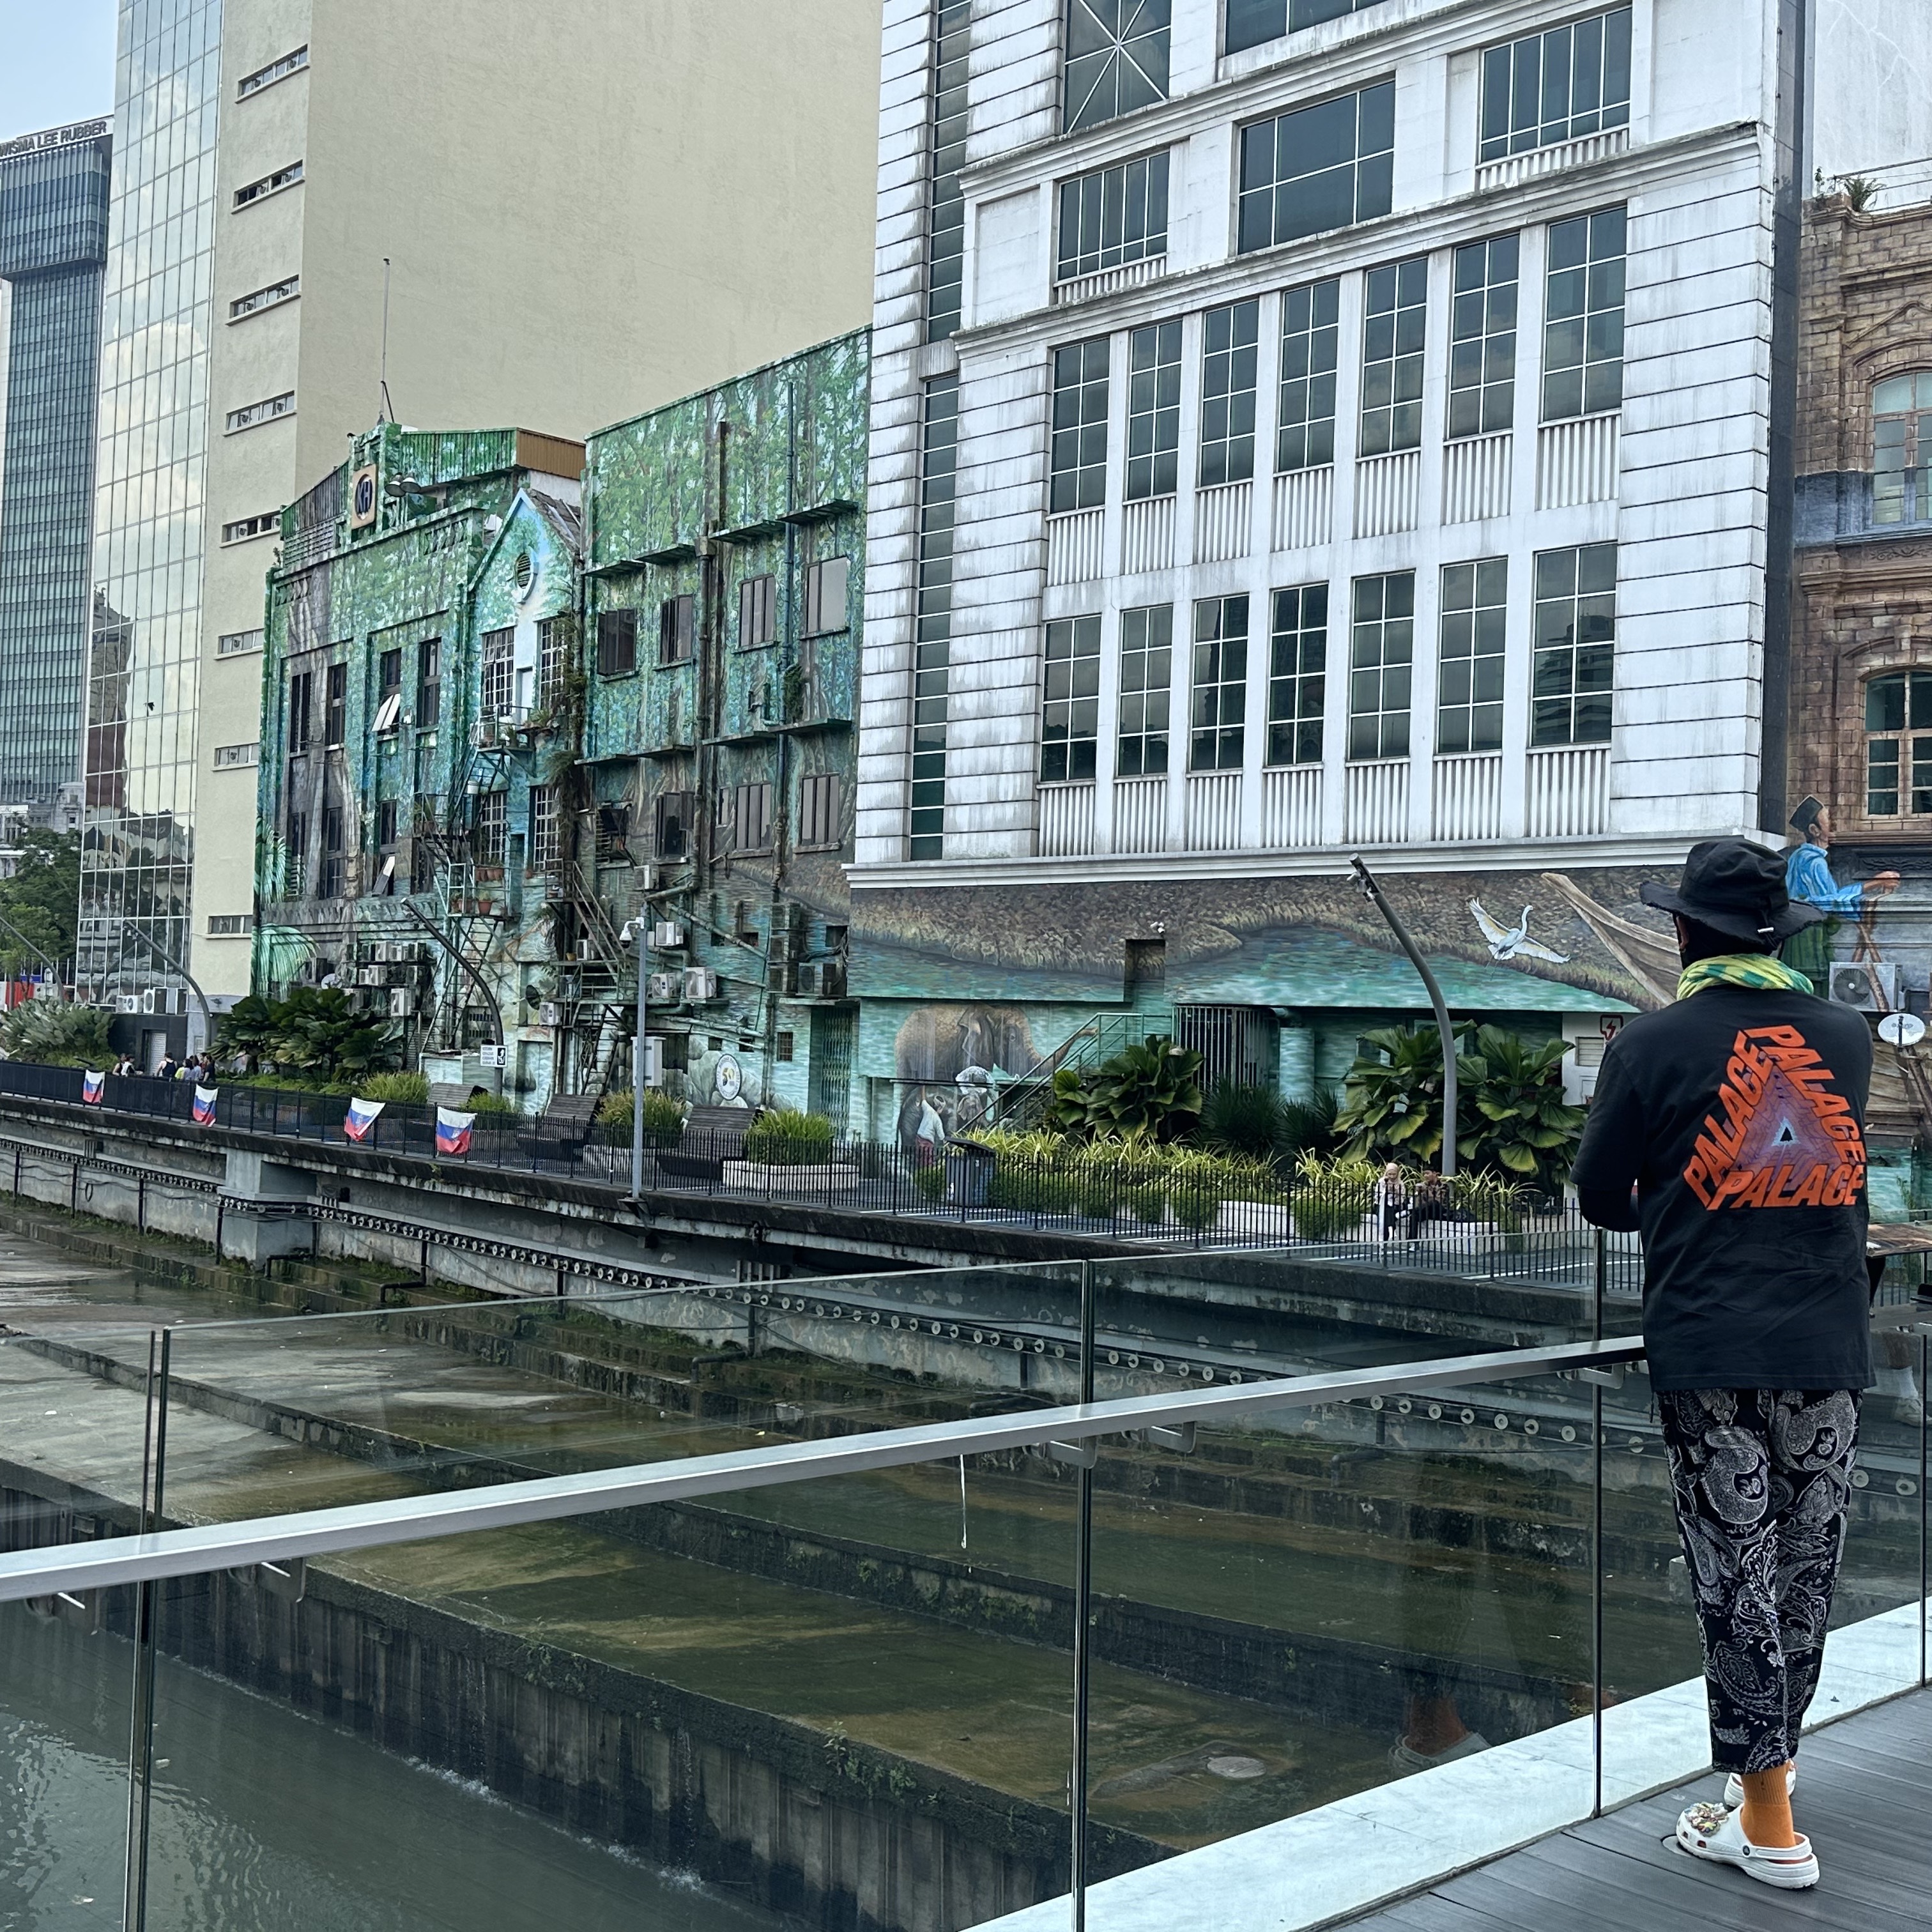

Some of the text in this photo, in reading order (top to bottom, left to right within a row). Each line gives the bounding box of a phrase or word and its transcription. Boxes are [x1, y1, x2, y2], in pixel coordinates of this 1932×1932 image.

[37, 132, 58, 148] LEE
[61, 121, 106, 142] RUBBER
[1683, 1030, 1773, 1208] PALACE
[1743, 1025, 1866, 1163] PALACE
[1706, 1164, 1864, 1211] PALACE
